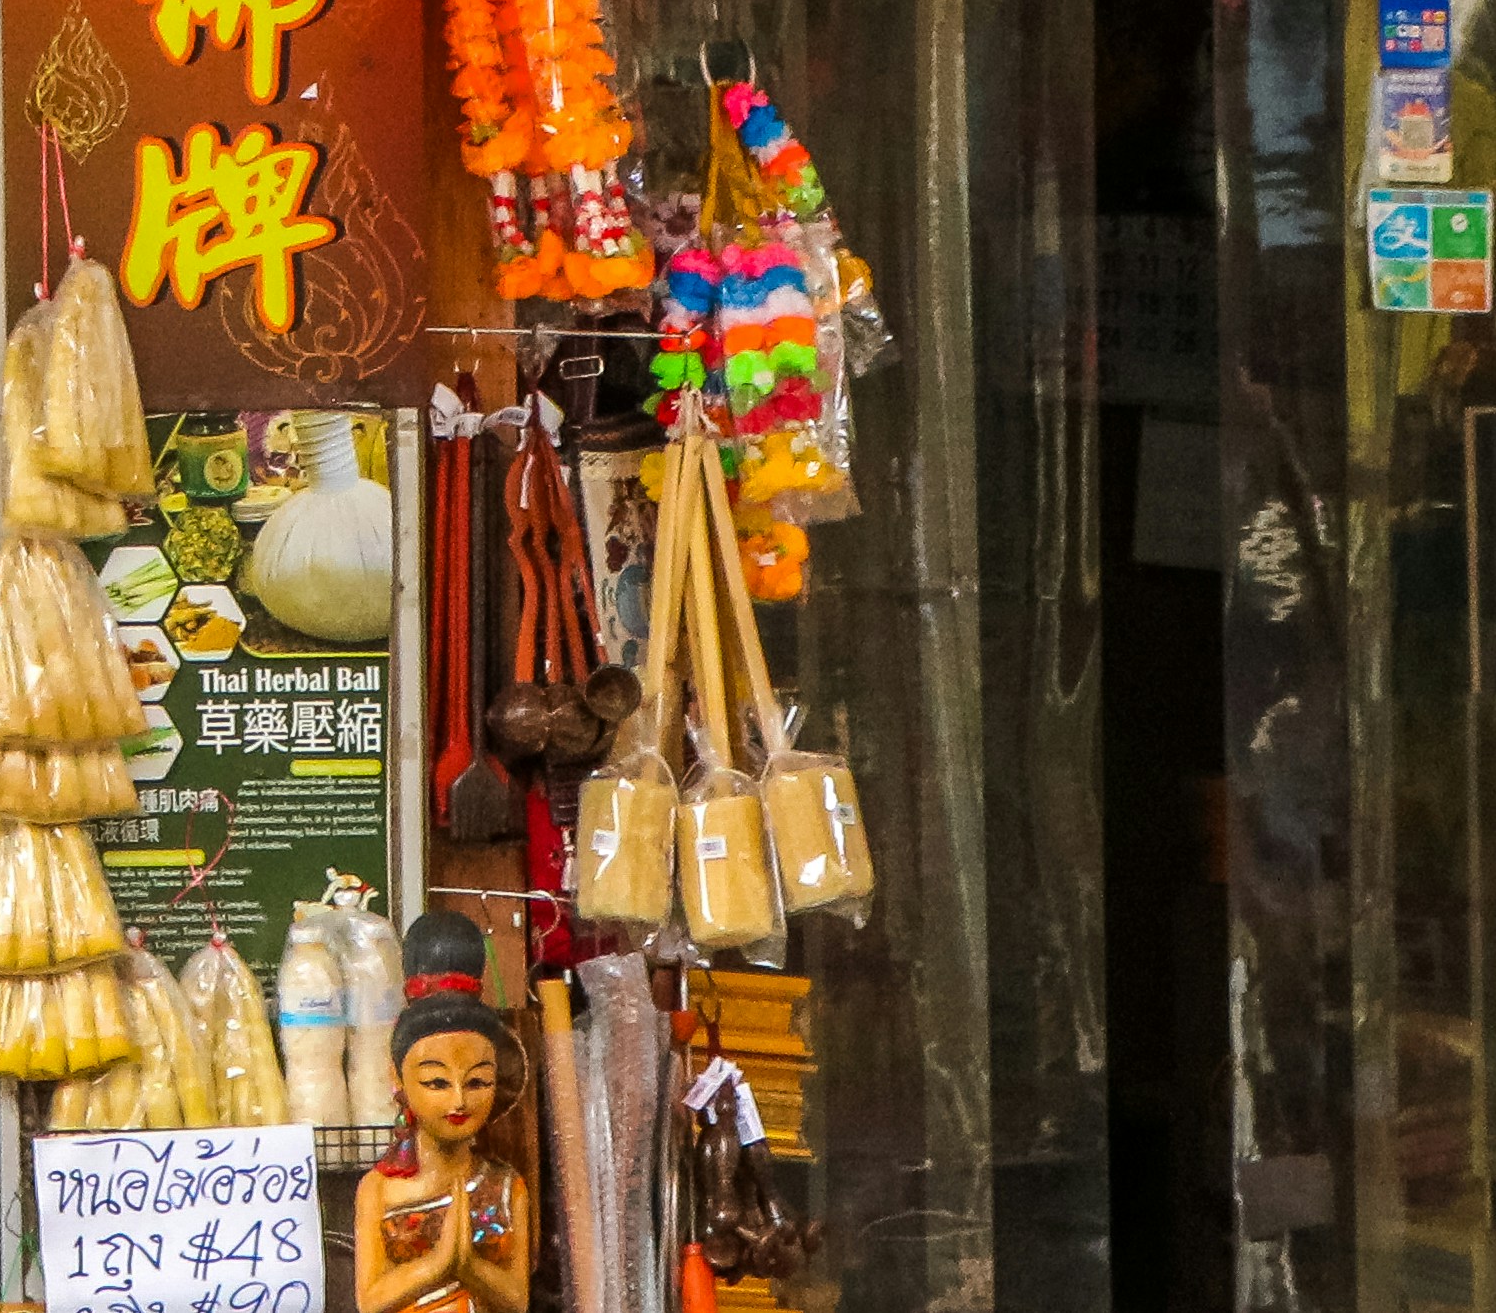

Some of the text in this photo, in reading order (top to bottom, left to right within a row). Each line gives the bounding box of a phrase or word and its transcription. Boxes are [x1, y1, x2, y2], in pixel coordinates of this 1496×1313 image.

[198, 664, 381, 694] Thai Herbal Ball
[195, 697, 382, 756] 草藥壓縮
[180, 1218, 302, 1282] $48
